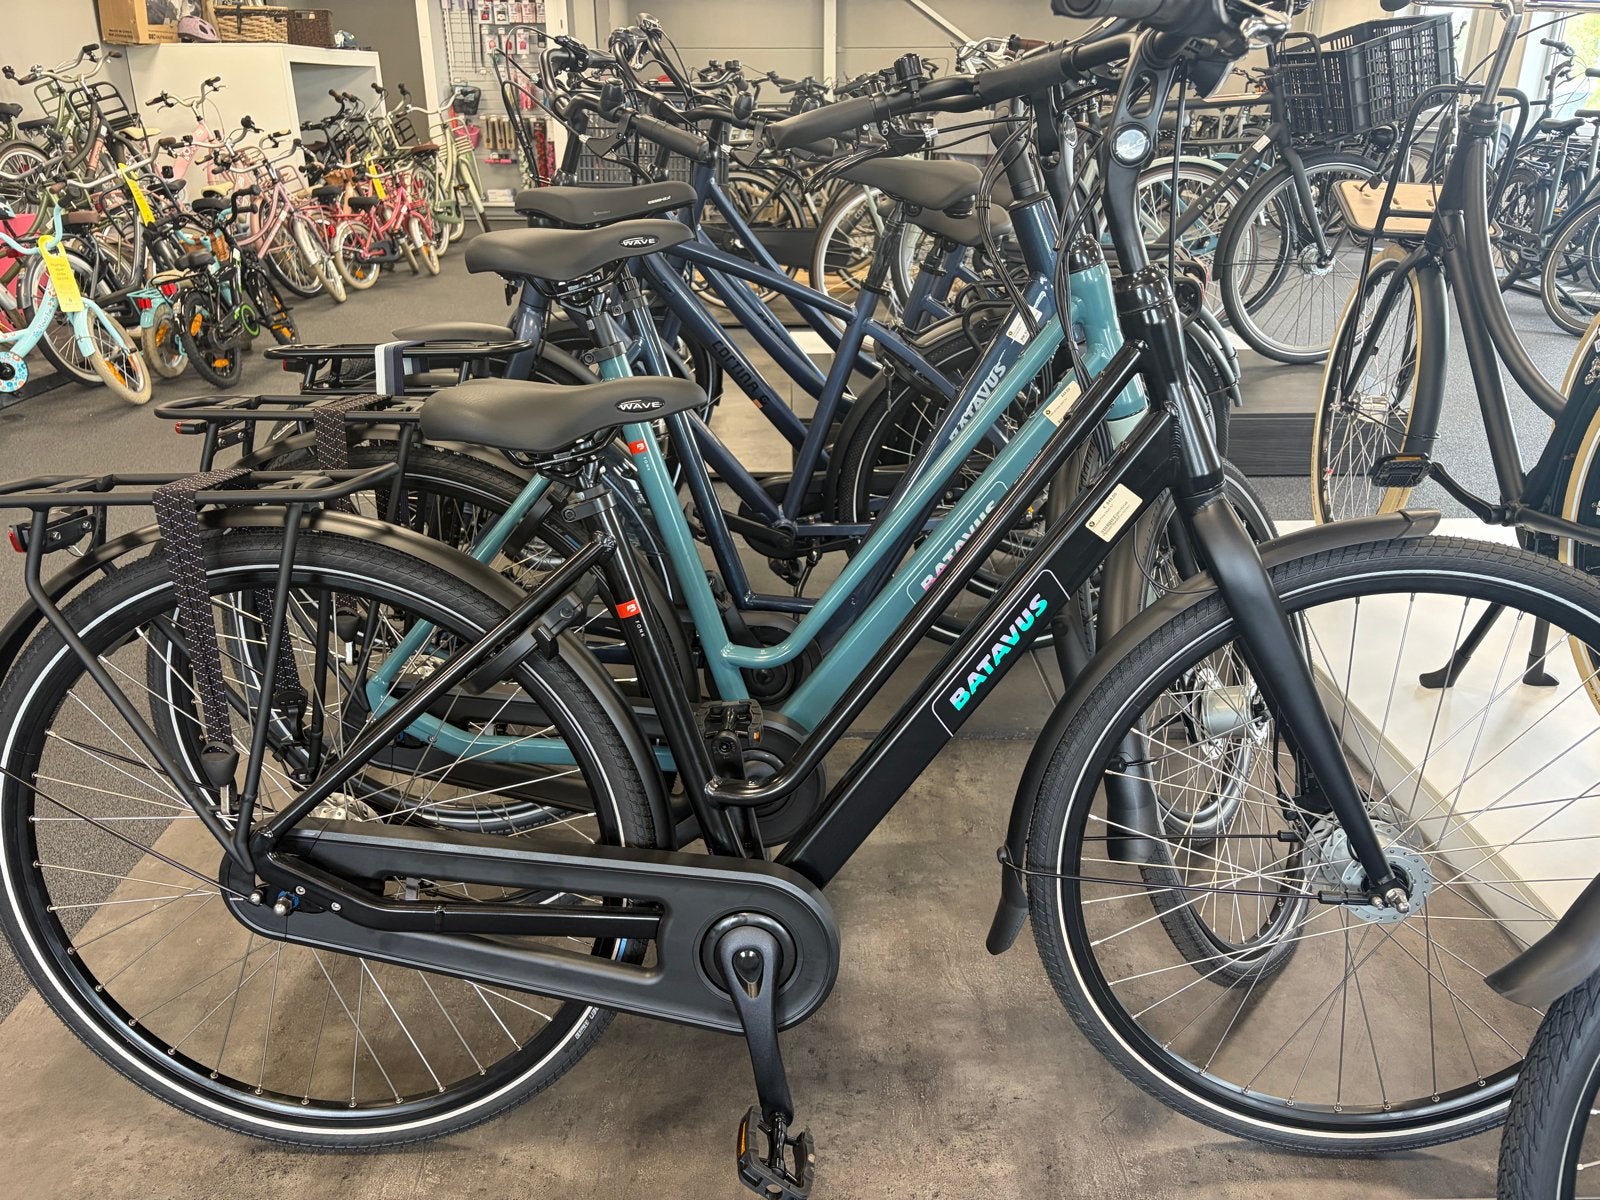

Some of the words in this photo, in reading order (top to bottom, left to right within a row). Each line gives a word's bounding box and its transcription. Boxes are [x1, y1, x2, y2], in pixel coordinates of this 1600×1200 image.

[1197, 158, 1249, 210] GAZELLE
[621, 238, 655, 247] WAVE
[619, 401, 662, 410] WAVE
[949, 593, 1048, 711] BATAVUS
